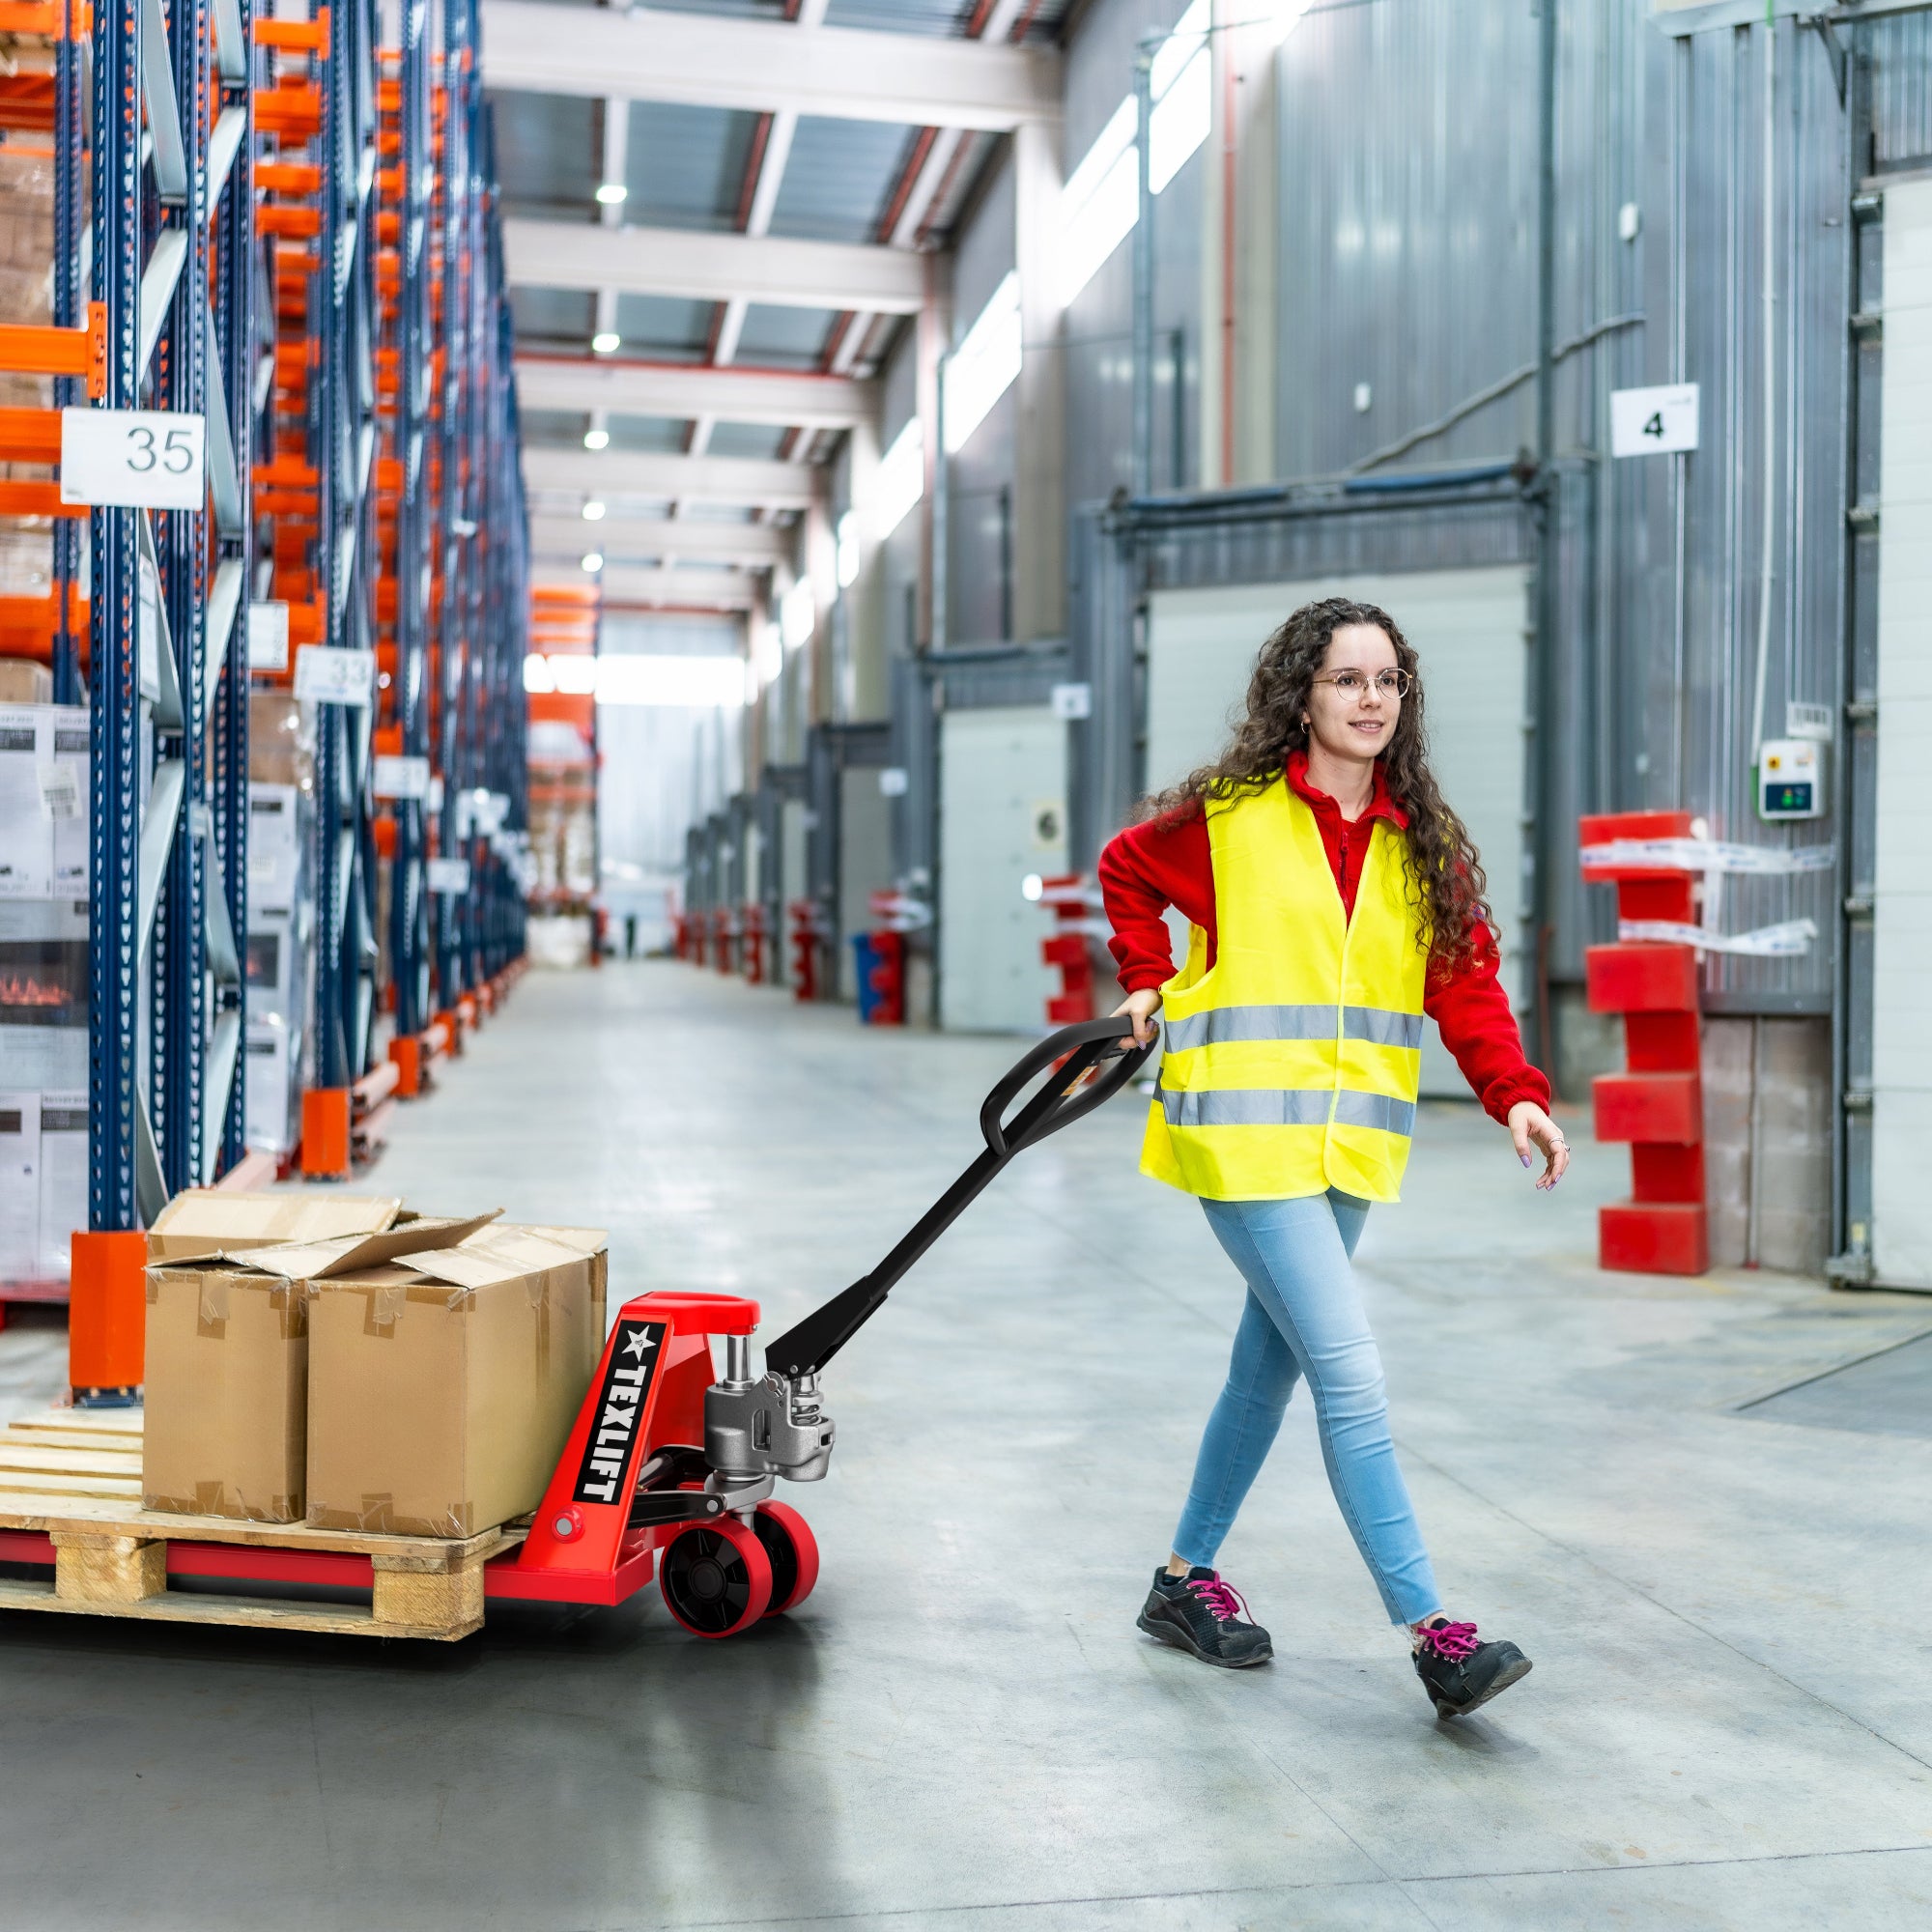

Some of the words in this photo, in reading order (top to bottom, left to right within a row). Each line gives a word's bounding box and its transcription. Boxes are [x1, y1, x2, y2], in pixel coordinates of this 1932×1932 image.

[1643, 412, 1664, 438] 4
[127, 427, 193, 473] 35
[582, 1365, 647, 1501] TEXLIFT
